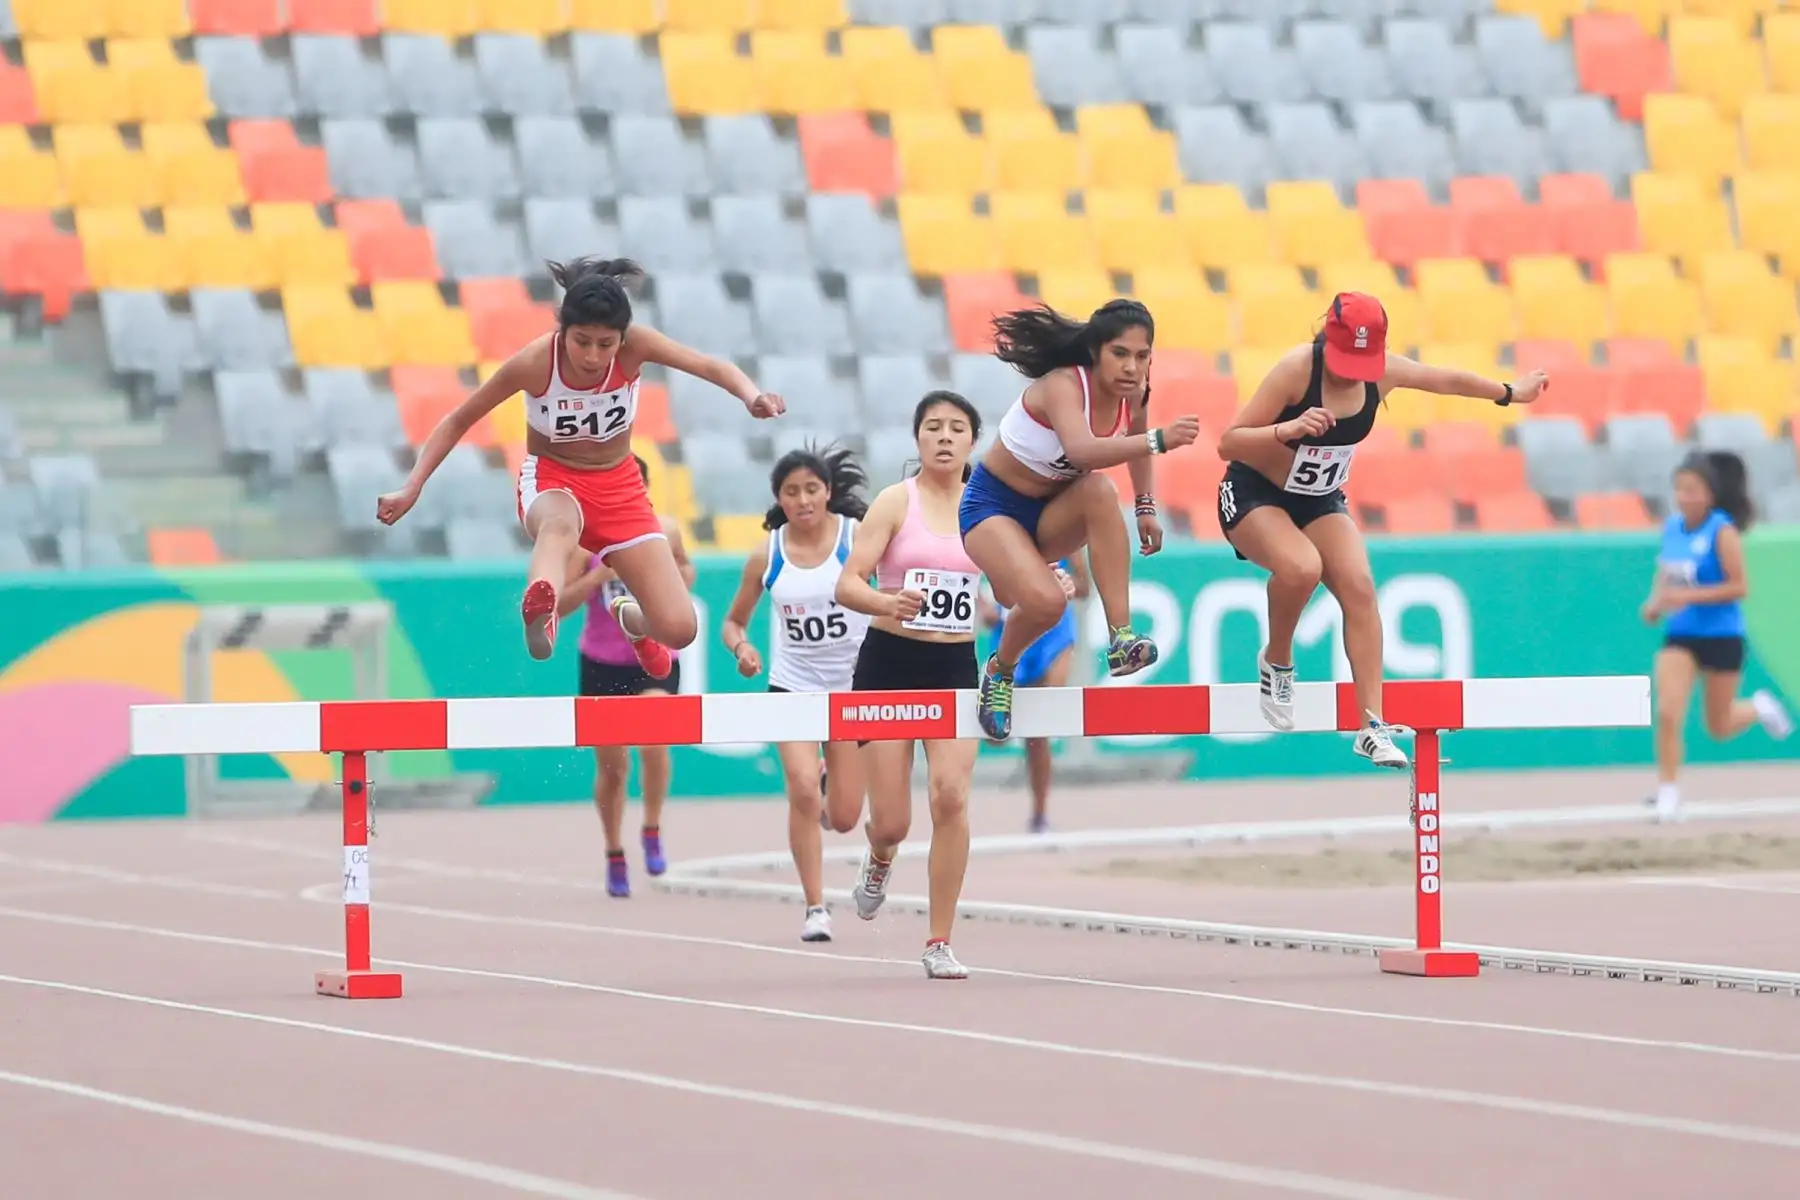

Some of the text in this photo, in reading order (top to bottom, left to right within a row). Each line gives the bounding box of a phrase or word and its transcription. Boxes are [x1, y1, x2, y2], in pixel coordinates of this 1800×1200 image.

[555, 405, 627, 437] 512
[786, 612, 848, 642] 505
[858, 704, 943, 721] MONDO
[1418, 792, 1440, 894] MONDO
